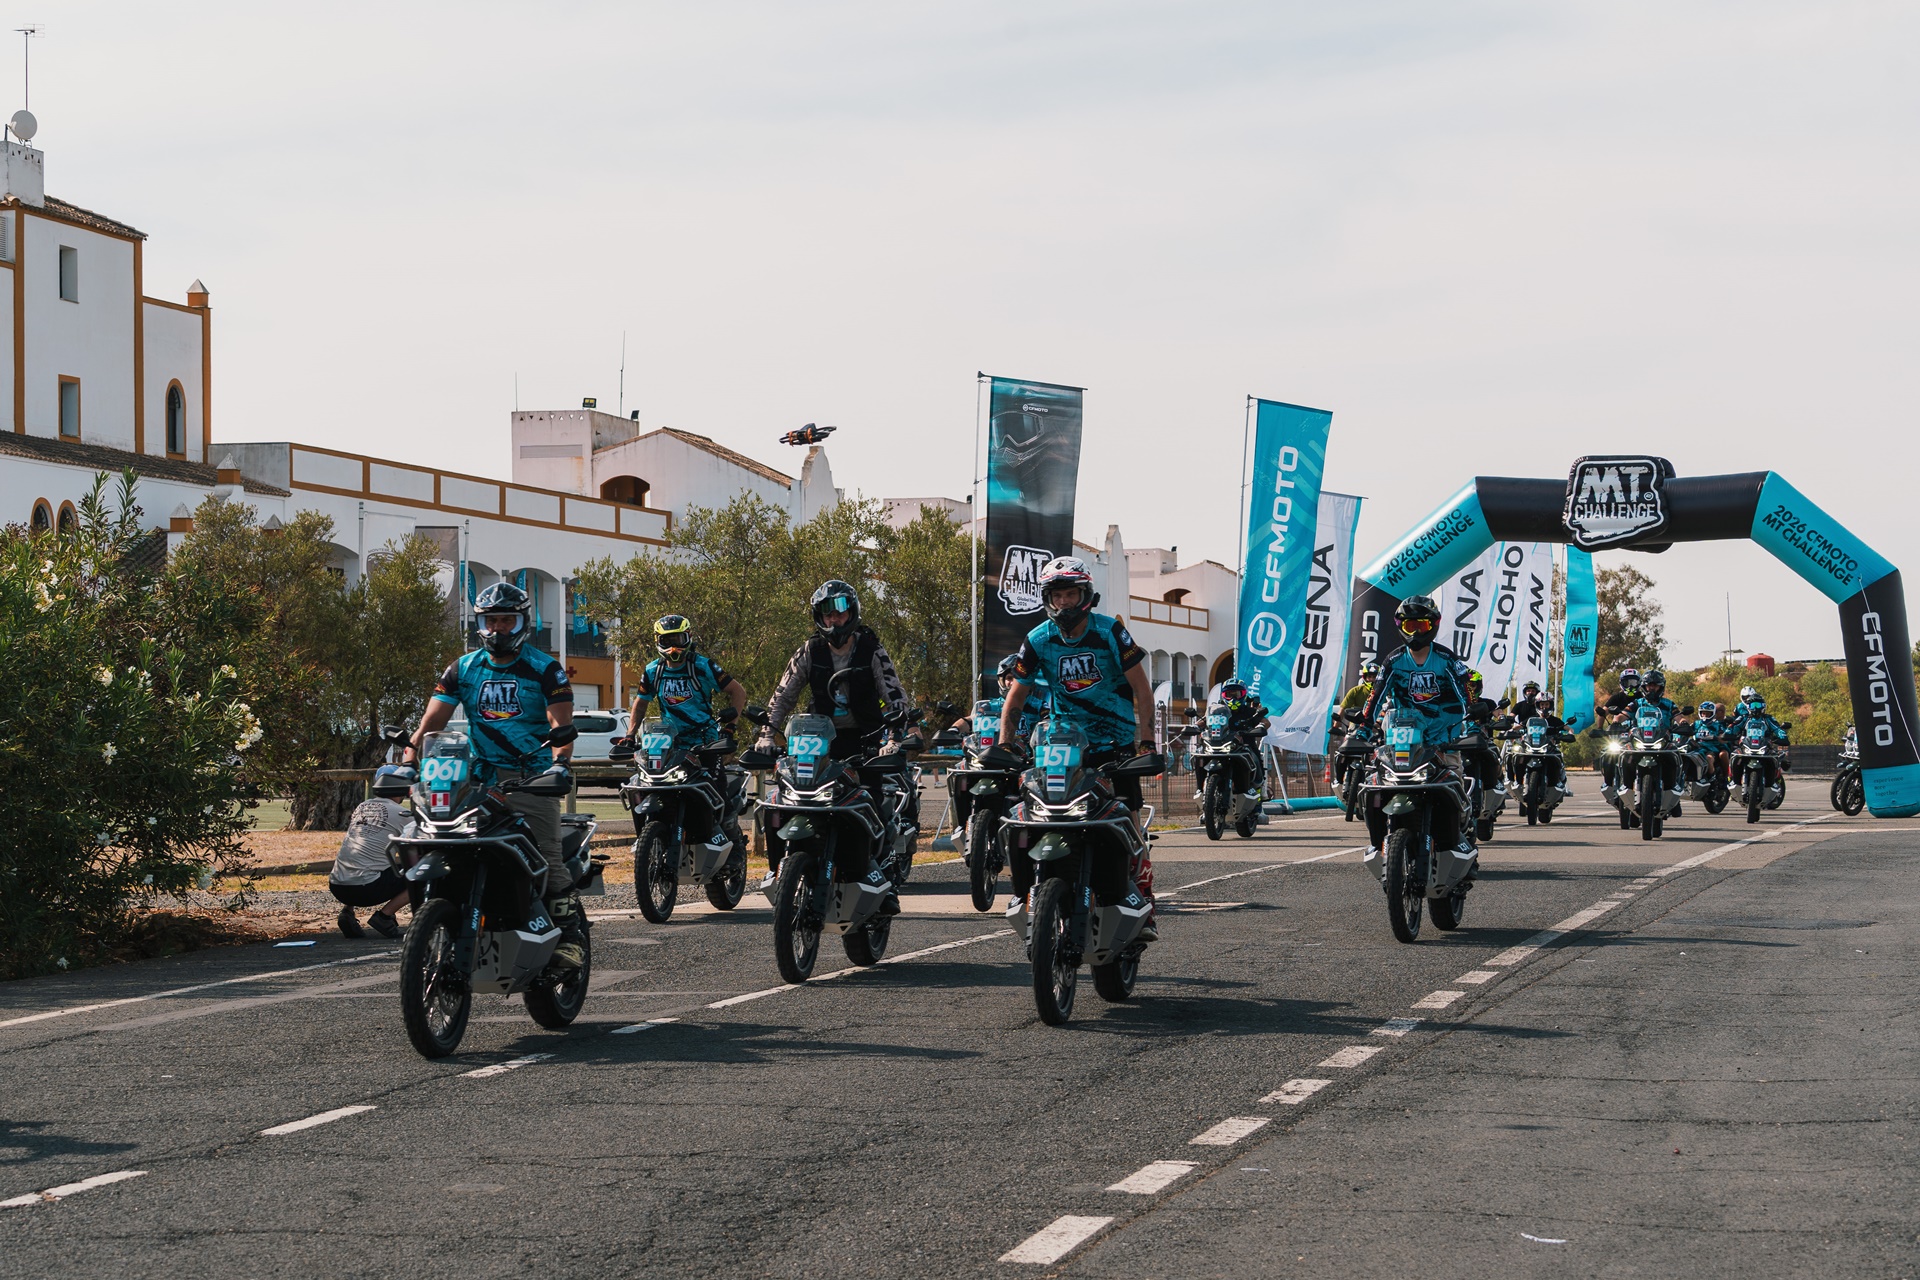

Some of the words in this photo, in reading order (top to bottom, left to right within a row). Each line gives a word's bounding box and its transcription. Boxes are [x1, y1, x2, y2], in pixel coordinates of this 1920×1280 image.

[1578, 466, 1650, 503] MT
[1574, 503, 1656, 520] CHALLENGE
[1261, 445, 1299, 603] CFMOTO
[1383, 546, 1414, 575] 2026
[1413, 508, 1462, 549] CFMOTO
[1773, 504, 1807, 534] 2026
[1806, 529, 1858, 571] CFMOTO
[1387, 566, 1407, 587] MT
[1405, 514, 1475, 572] CHALLENGE
[1762, 513, 1785, 532] MT
[1782, 528, 1854, 586] CHALLENGE
[1006, 550, 1050, 585] MT
[1004, 579, 1043, 599] CHALLEN
[1452, 568, 1484, 662] ENA
[1489, 545, 1524, 665] CHOHO
[1296, 543, 1335, 689] SENA
[1360, 610, 1380, 676] CFM
[1570, 627, 1590, 641] MT
[1061, 655, 1092, 676] MT
[666, 679, 687, 692] MT
[1248, 666, 1262, 698] ther
[1411, 673, 1433, 689] MT
[1861, 611, 1894, 747] CFMOTO
[481, 683, 514, 704] MT
[480, 703, 519, 713] CHALLENGE
[1207, 715, 1227, 726] 083
[642, 734, 671, 749] 072
[791, 737, 823, 755] 152
[1392, 728, 1414, 744] 131
[1043, 746, 1071, 766] 151
[424, 759, 462, 781] 061
[711, 833, 726, 845] 072
[1457, 842, 1470, 852] 131
[867, 870, 883, 883] 152
[1125, 893, 1141, 906] 151
[528, 916, 548, 932] 061
